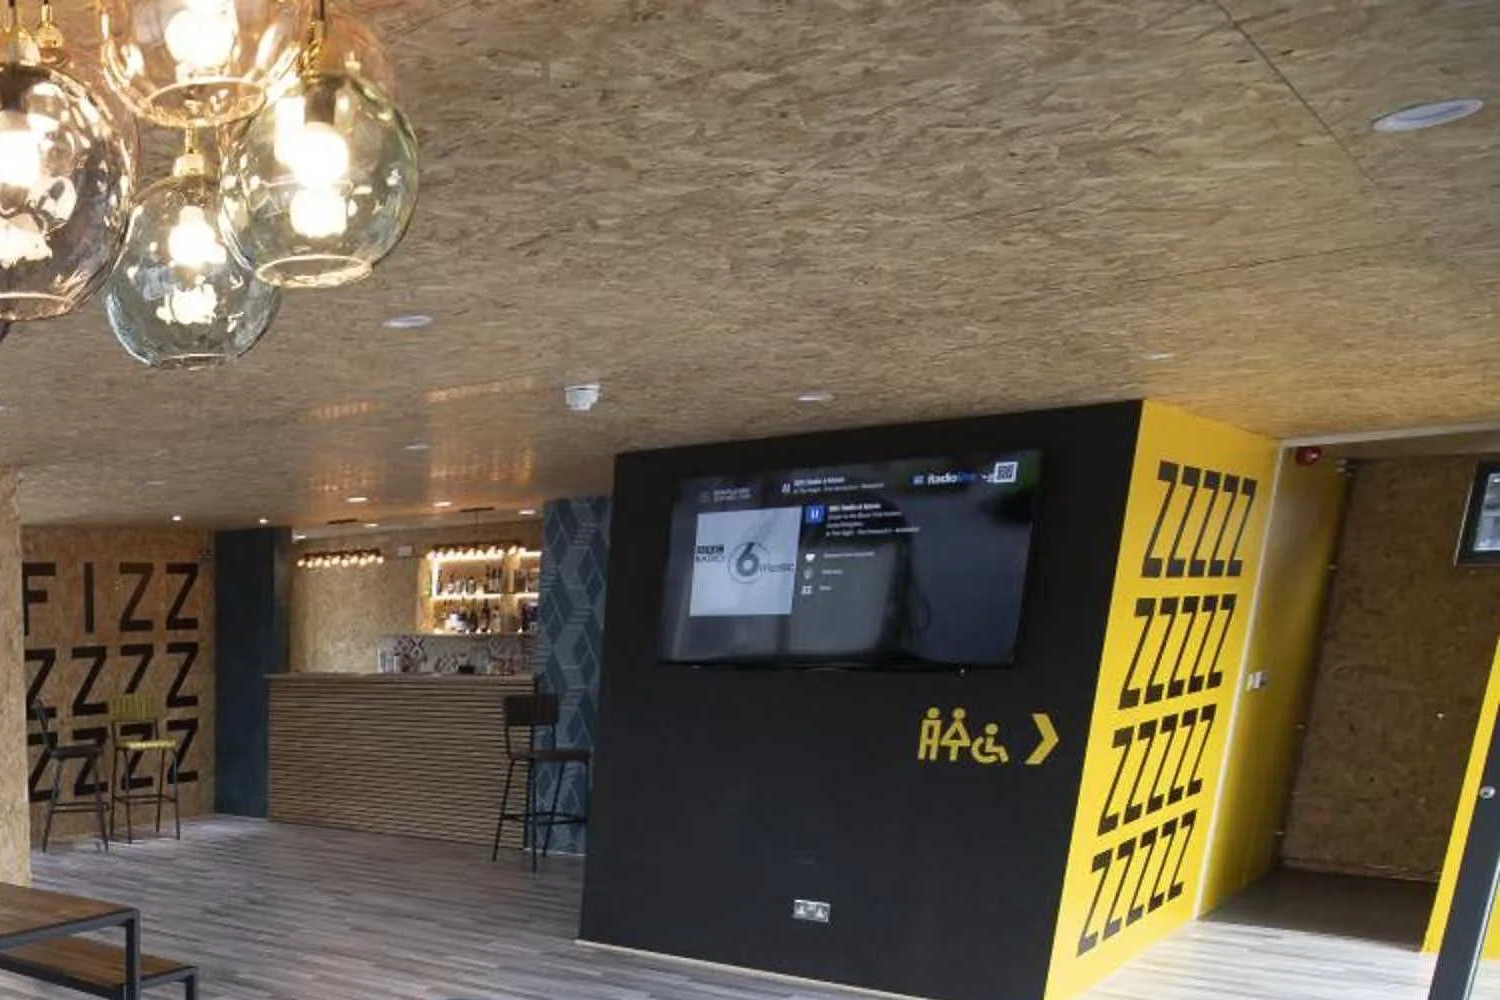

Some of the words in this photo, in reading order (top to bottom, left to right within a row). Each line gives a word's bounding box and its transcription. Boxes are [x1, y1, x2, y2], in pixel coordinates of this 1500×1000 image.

[1141, 460, 1258, 578] ZZZZZ
[22, 561, 198, 636] FIZZ
[1118, 593, 1237, 710] ZZZZZ
[1097, 703, 1217, 836] ZZZZZ
[1076, 809, 1197, 957] ZZZZZ
